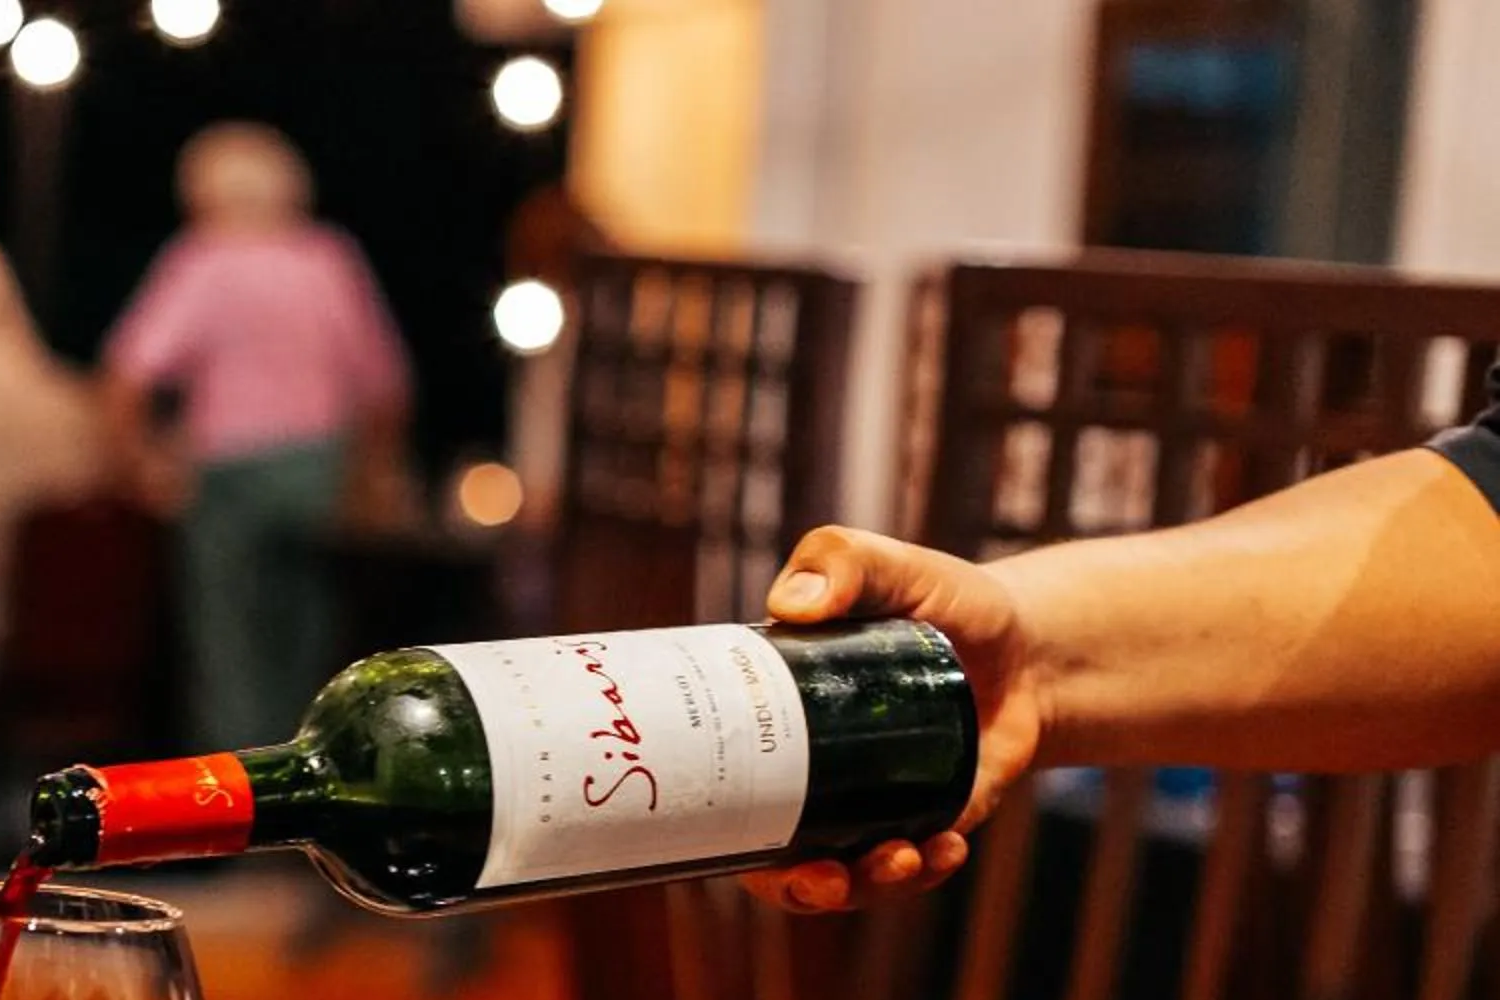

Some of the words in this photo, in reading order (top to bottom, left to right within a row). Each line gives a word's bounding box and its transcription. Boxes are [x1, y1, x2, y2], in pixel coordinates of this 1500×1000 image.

[675, 674, 702, 729] MERLOT
[729, 646, 778, 753] UNDRAGA
[539, 752, 552, 822] GRAN
